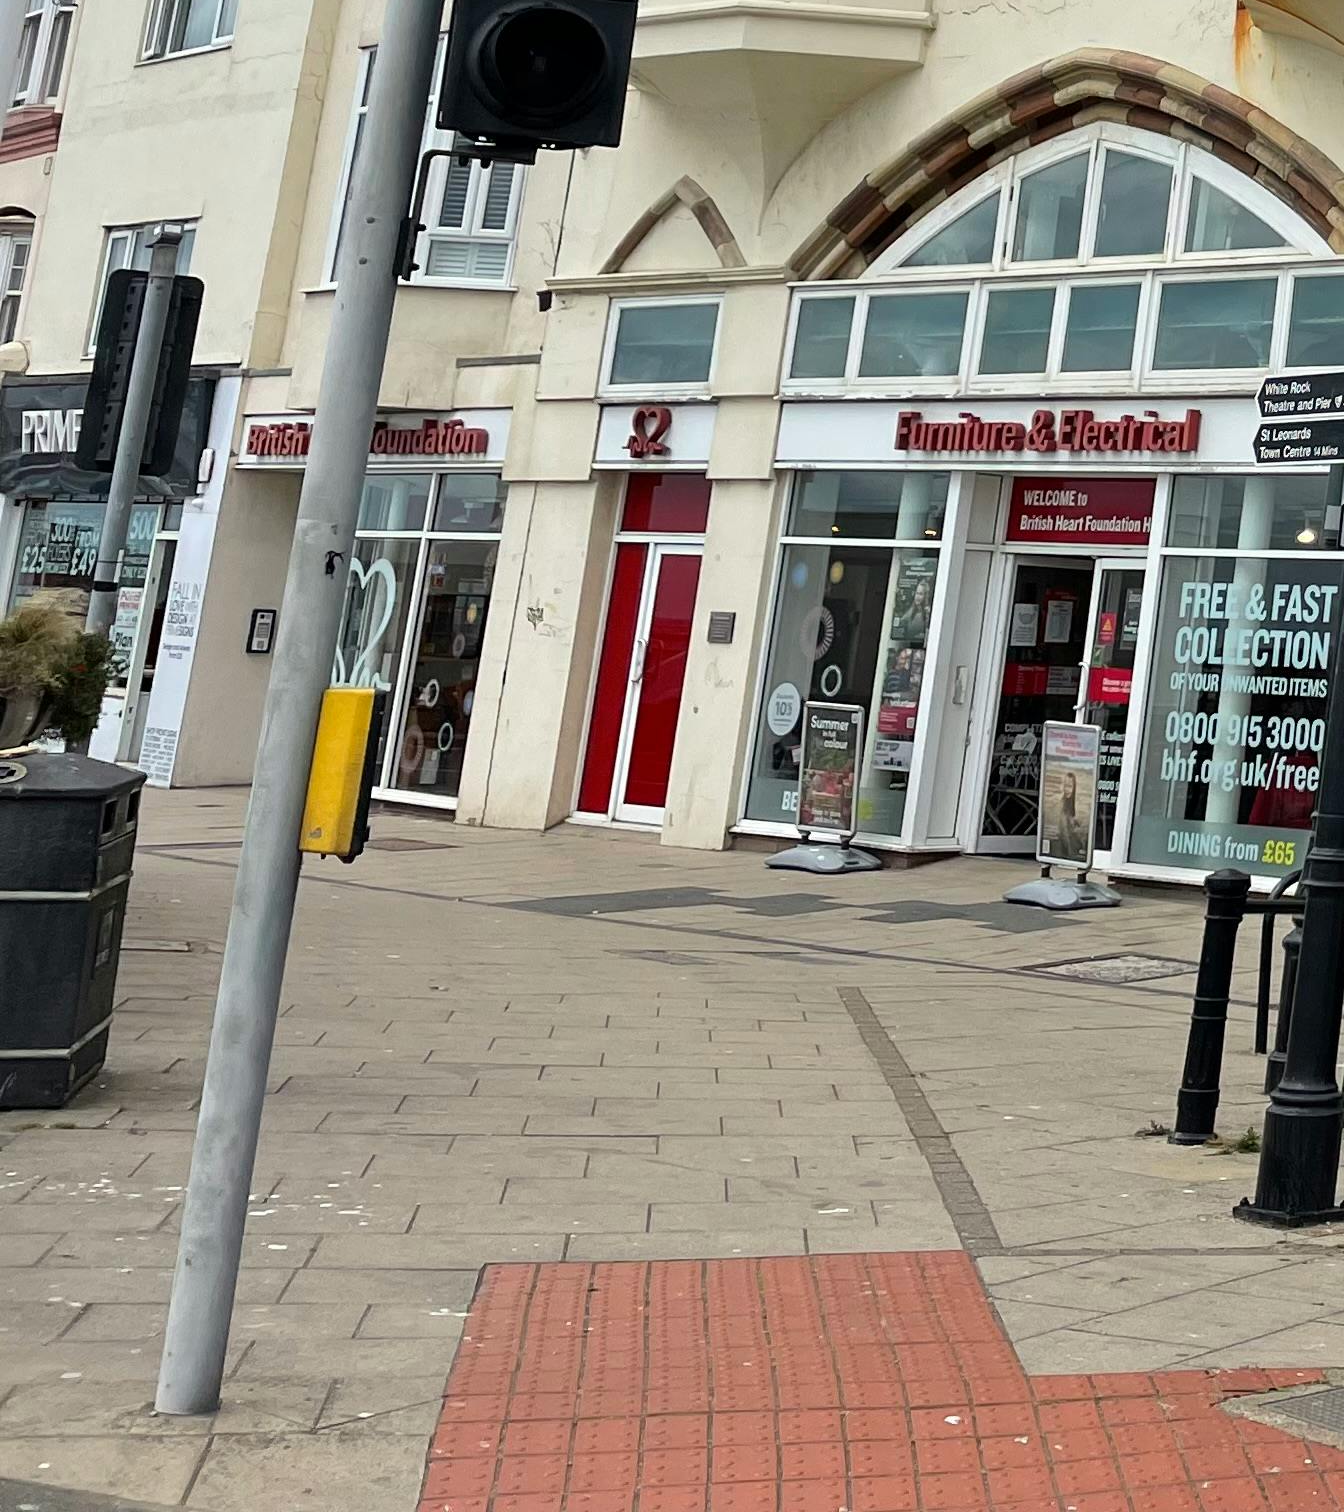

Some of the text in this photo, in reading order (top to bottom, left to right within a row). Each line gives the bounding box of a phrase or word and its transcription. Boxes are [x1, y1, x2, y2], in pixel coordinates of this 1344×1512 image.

[1265, 381, 1311, 396] White Rock
[1264, 400, 1295, 413] Theatre
[1297, 399, 1314, 411] and
[1315, 396, 1332, 410] Pier
[247, 419, 486, 456] British oundation
[894, 409, 1202, 453] Furniture & Electrical
[1261, 427, 1312, 442] St Leonards
[1260, 446, 1280, 459] Town
[1283, 445, 1311, 458] Centre
[1024, 490, 1088, 506] WELCOME to
[130, 511, 156, 540] 500
[1020, 515, 1054, 531] British
[1055, 515, 1084, 531] Heart
[1085, 516, 1141, 533] Foundation
[21, 546, 47, 573] £25
[70, 548, 97, 576] £49
[1179, 582, 1338, 623] FREE & FAST
[1174, 626, 1331, 670] COLLECTION
[1170, 672, 1186, 690] OF
[1187, 672, 1219, 692] YOUR
[1289, 677, 1328, 698] ITEMS
[811, 715, 849, 731] Summer
[1165, 711, 1221, 745] 0800
[1226, 714, 1264, 748] 915
[1266, 716, 1325, 752] 3000
[824, 739, 848, 750] colour
[1160, 749, 1320, 792] bhf.org.uk/free
[1168, 830, 1295, 866] DINING from £65
